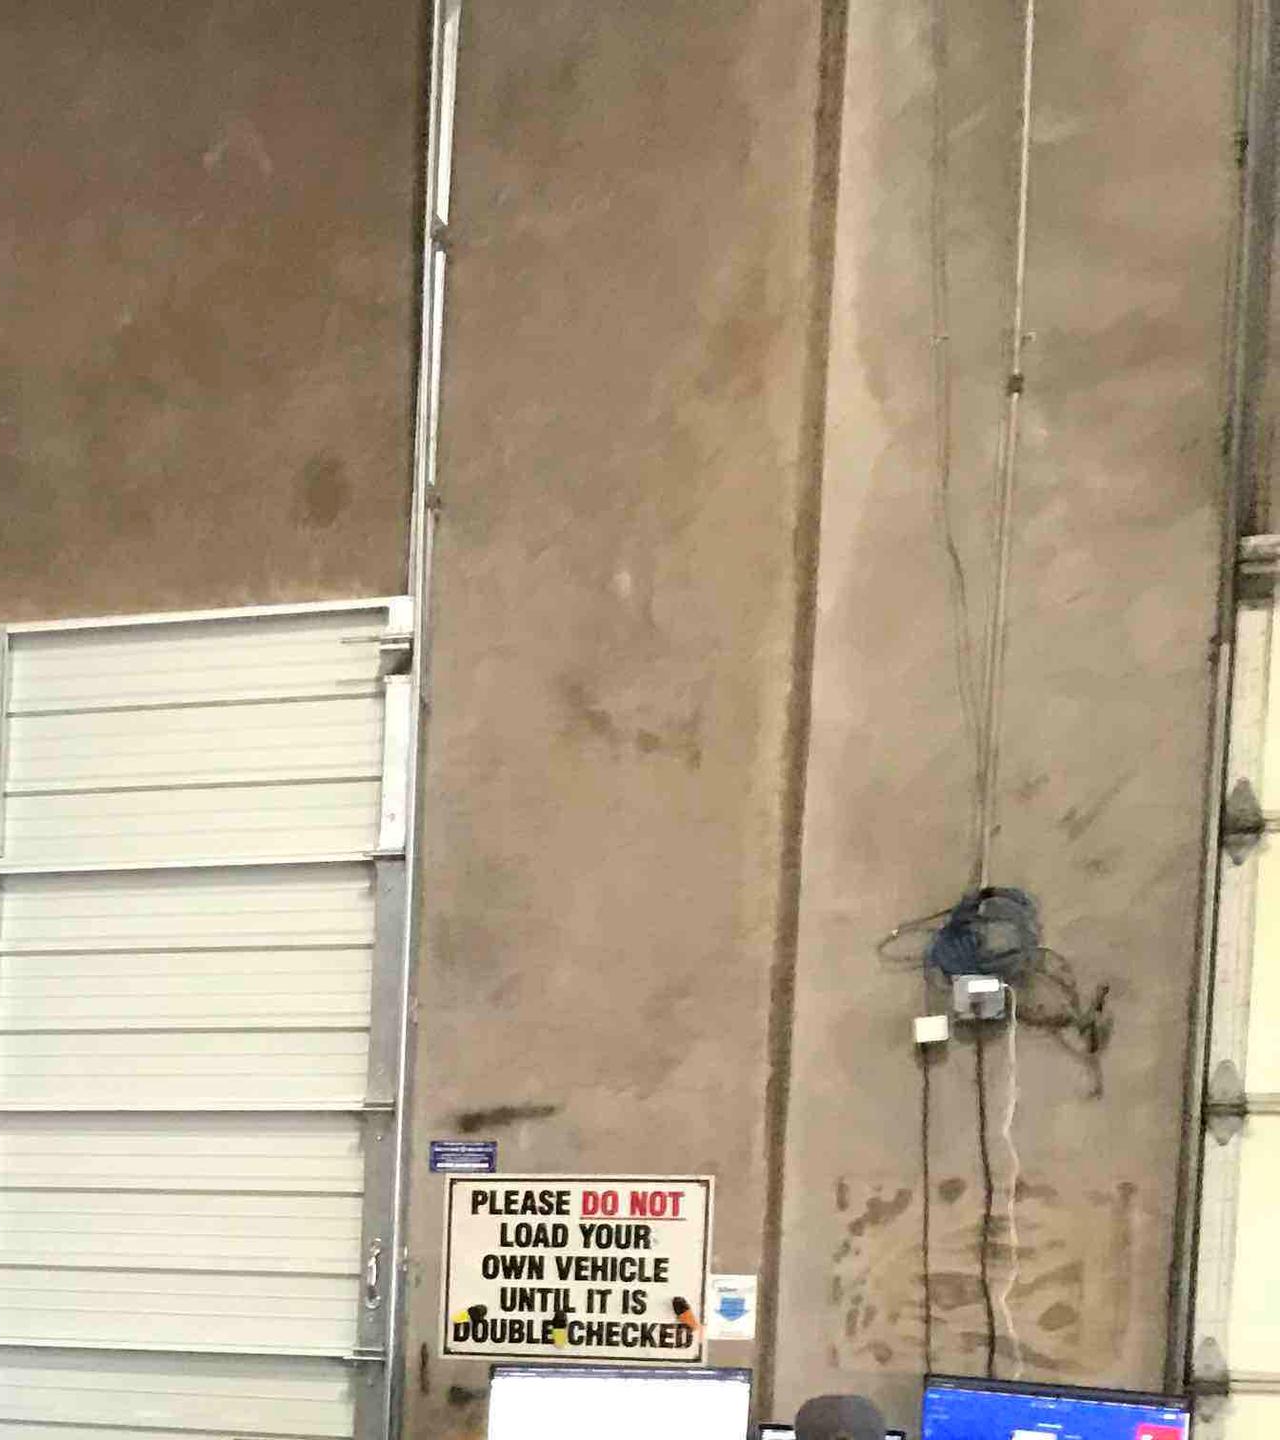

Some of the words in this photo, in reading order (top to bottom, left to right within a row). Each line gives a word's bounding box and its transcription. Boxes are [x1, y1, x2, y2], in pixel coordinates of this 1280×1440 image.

[471, 1190, 571, 1216] PLEASE
[582, 1190, 618, 1216] DO
[629, 1190, 686, 1217] NOT
[500, 1222, 569, 1249] LOAD
[579, 1223, 652, 1250] YOUR
[482, 1254, 545, 1281] OWN
[555, 1256, 669, 1283] VEHICLE
[500, 1287, 575, 1313] UNTIL
[586, 1288, 612, 1314] IT
[622, 1289, 648, 1315] IS
[452, 1318, 555, 1345] DOUBLE
[567, 1320, 694, 1349] CHECKED
